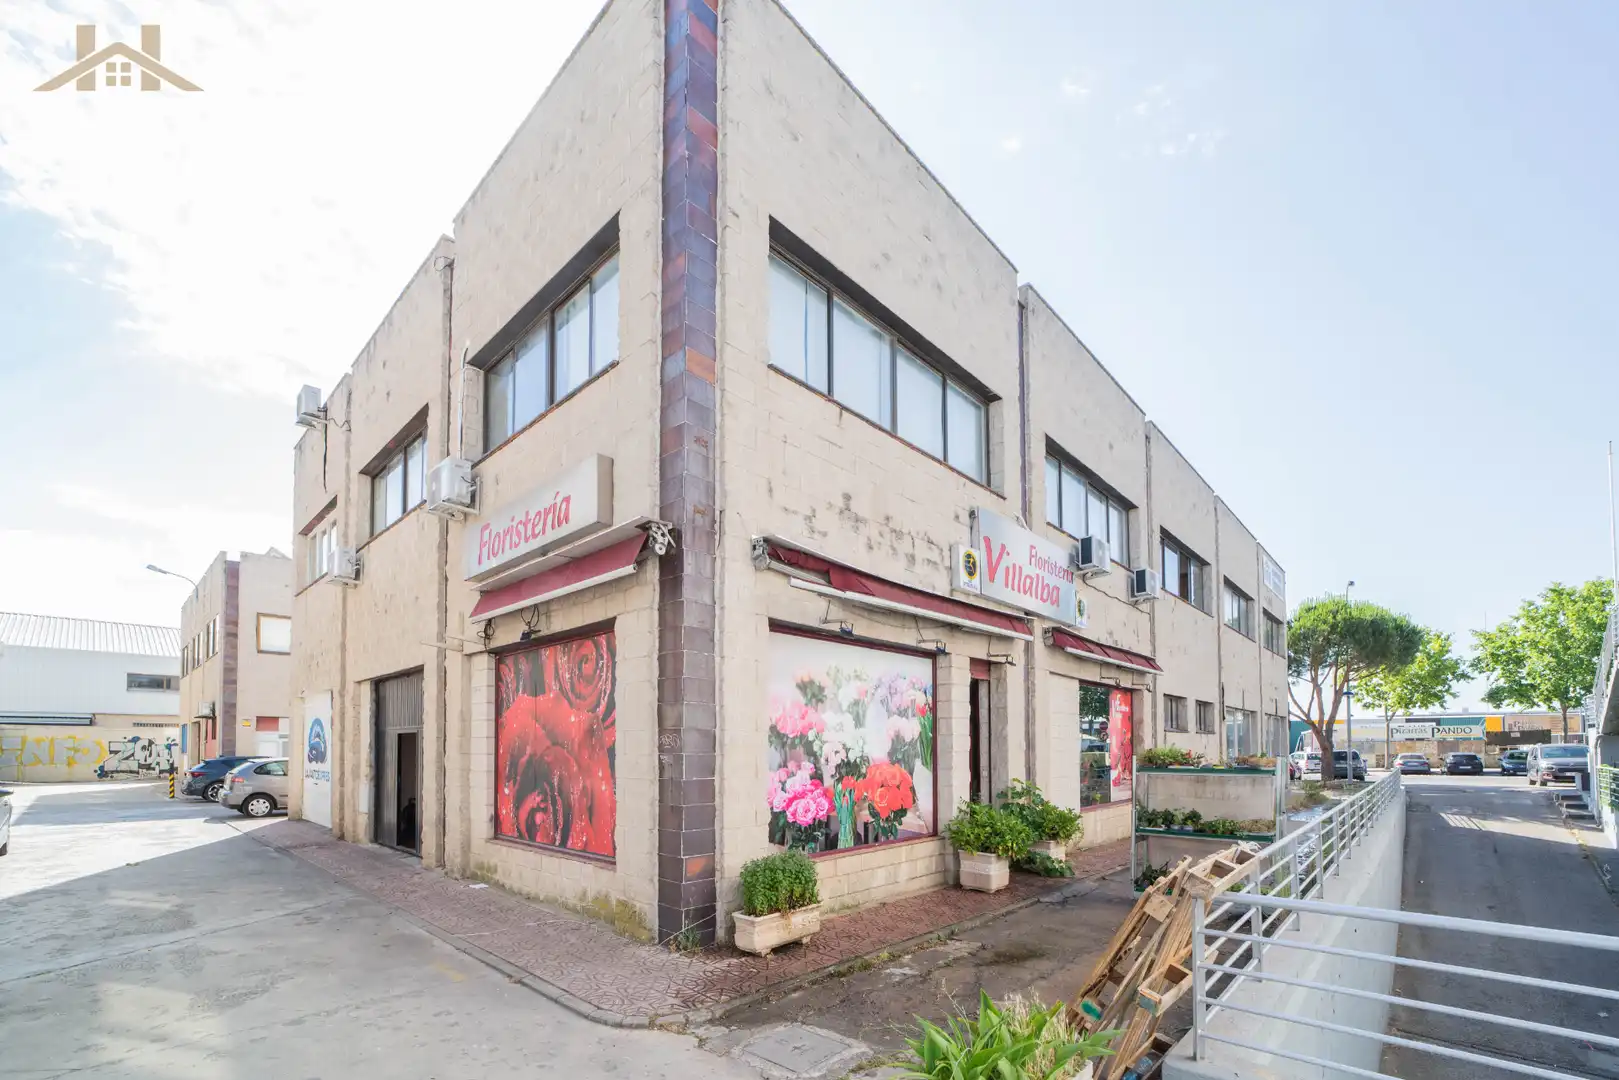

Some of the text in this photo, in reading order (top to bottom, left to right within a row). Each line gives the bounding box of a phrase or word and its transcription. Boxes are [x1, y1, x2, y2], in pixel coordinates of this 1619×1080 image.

[478, 491, 572, 566] Floristería
[982, 535, 1061, 608] Villalba
[1432, 726, 1473, 738] PANDO
